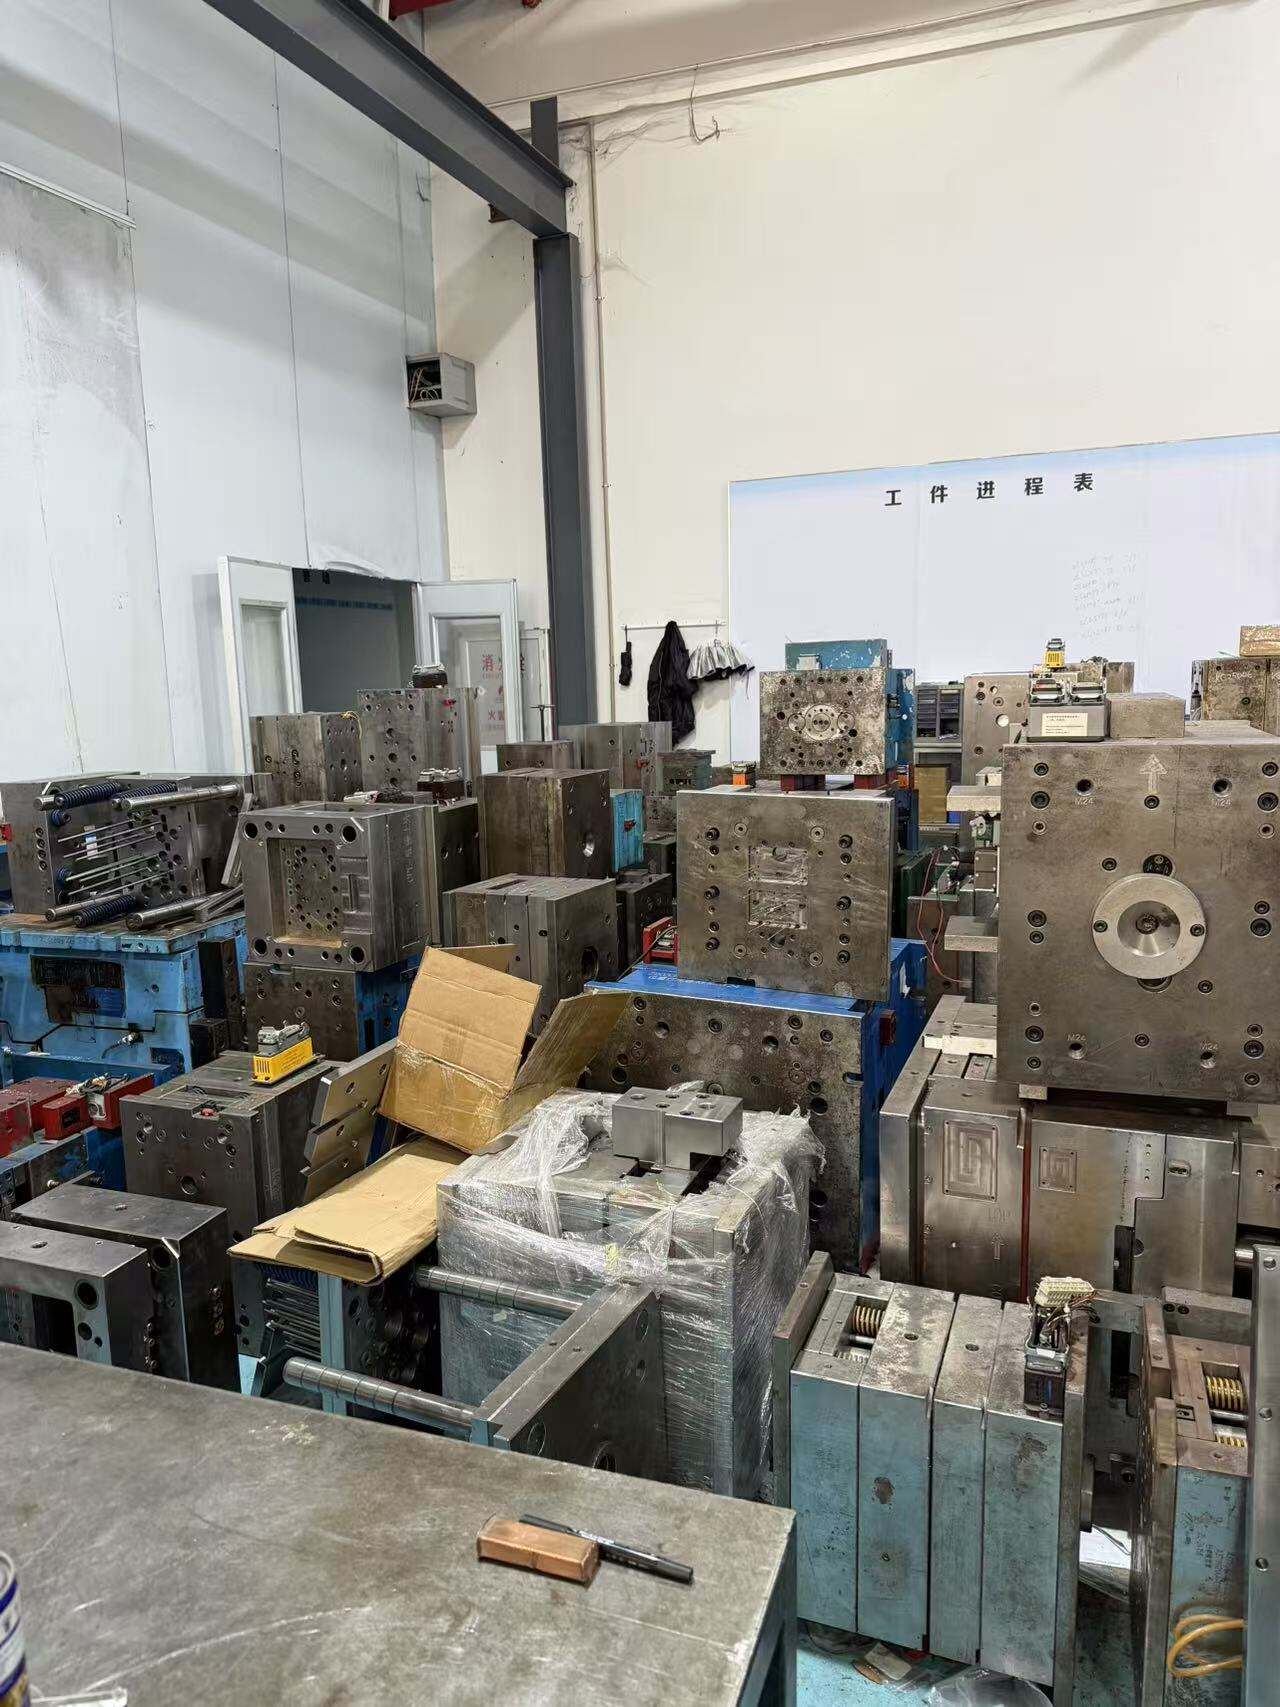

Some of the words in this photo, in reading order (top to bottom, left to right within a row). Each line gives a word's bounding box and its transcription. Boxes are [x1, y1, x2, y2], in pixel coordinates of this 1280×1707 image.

[884, 472, 1094, 507] 工件进程表
